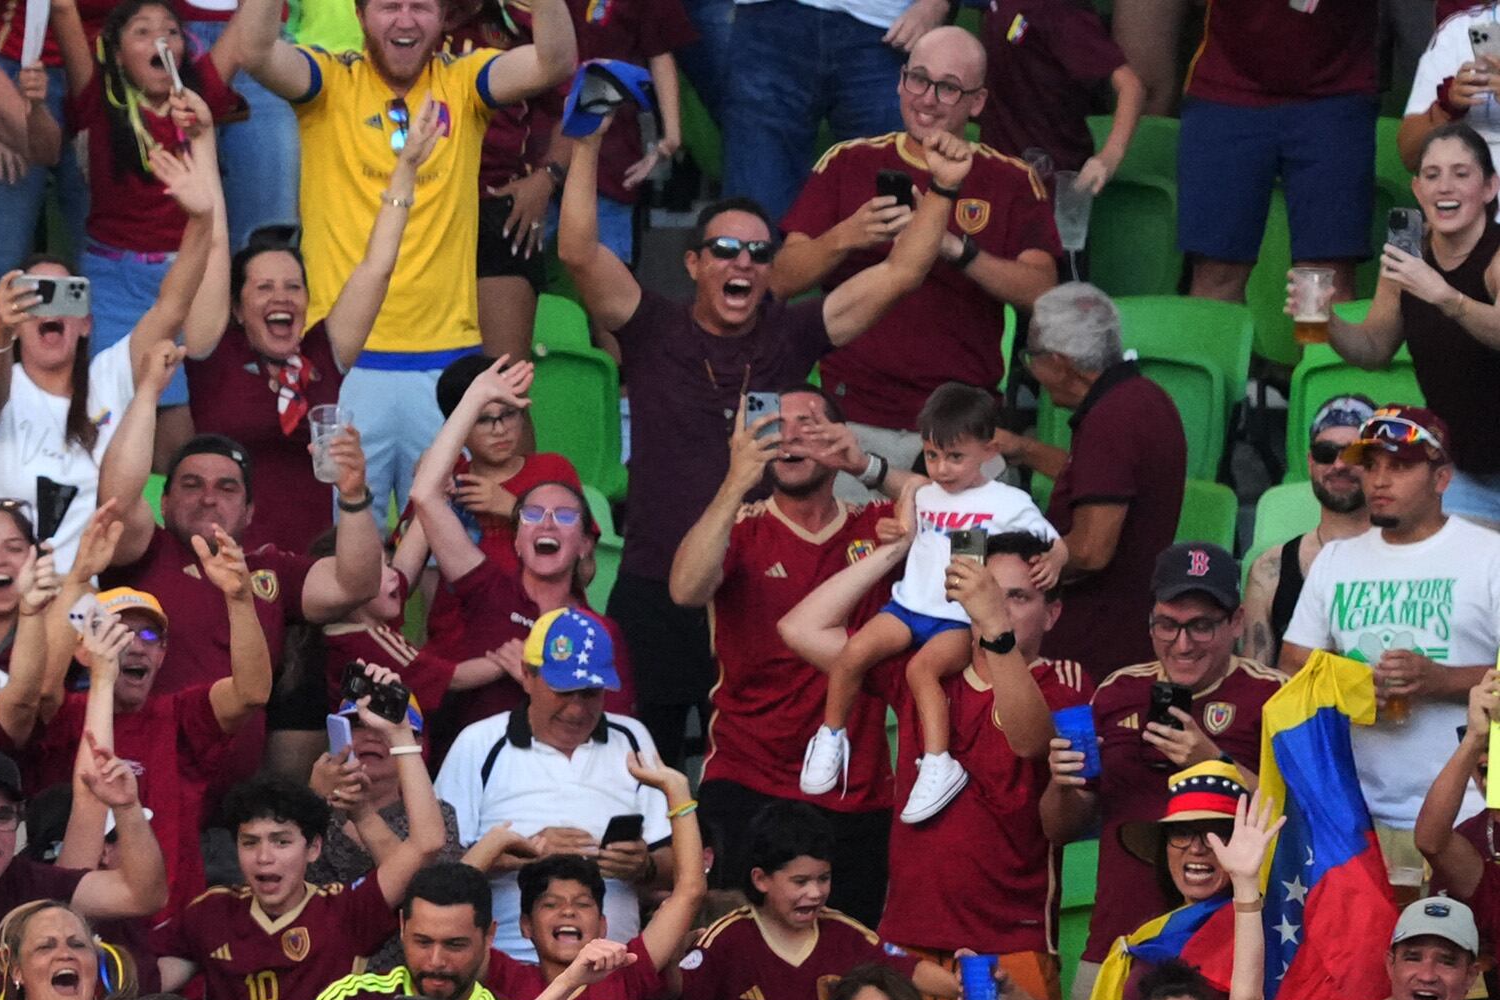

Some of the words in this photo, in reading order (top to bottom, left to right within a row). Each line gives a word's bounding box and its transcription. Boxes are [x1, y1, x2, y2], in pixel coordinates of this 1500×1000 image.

[1186, 549, 1211, 577] B
[1329, 579, 1402, 631] NEW
[1403, 578, 1455, 604] YORK
[1348, 600, 1453, 640] CHAMPS
